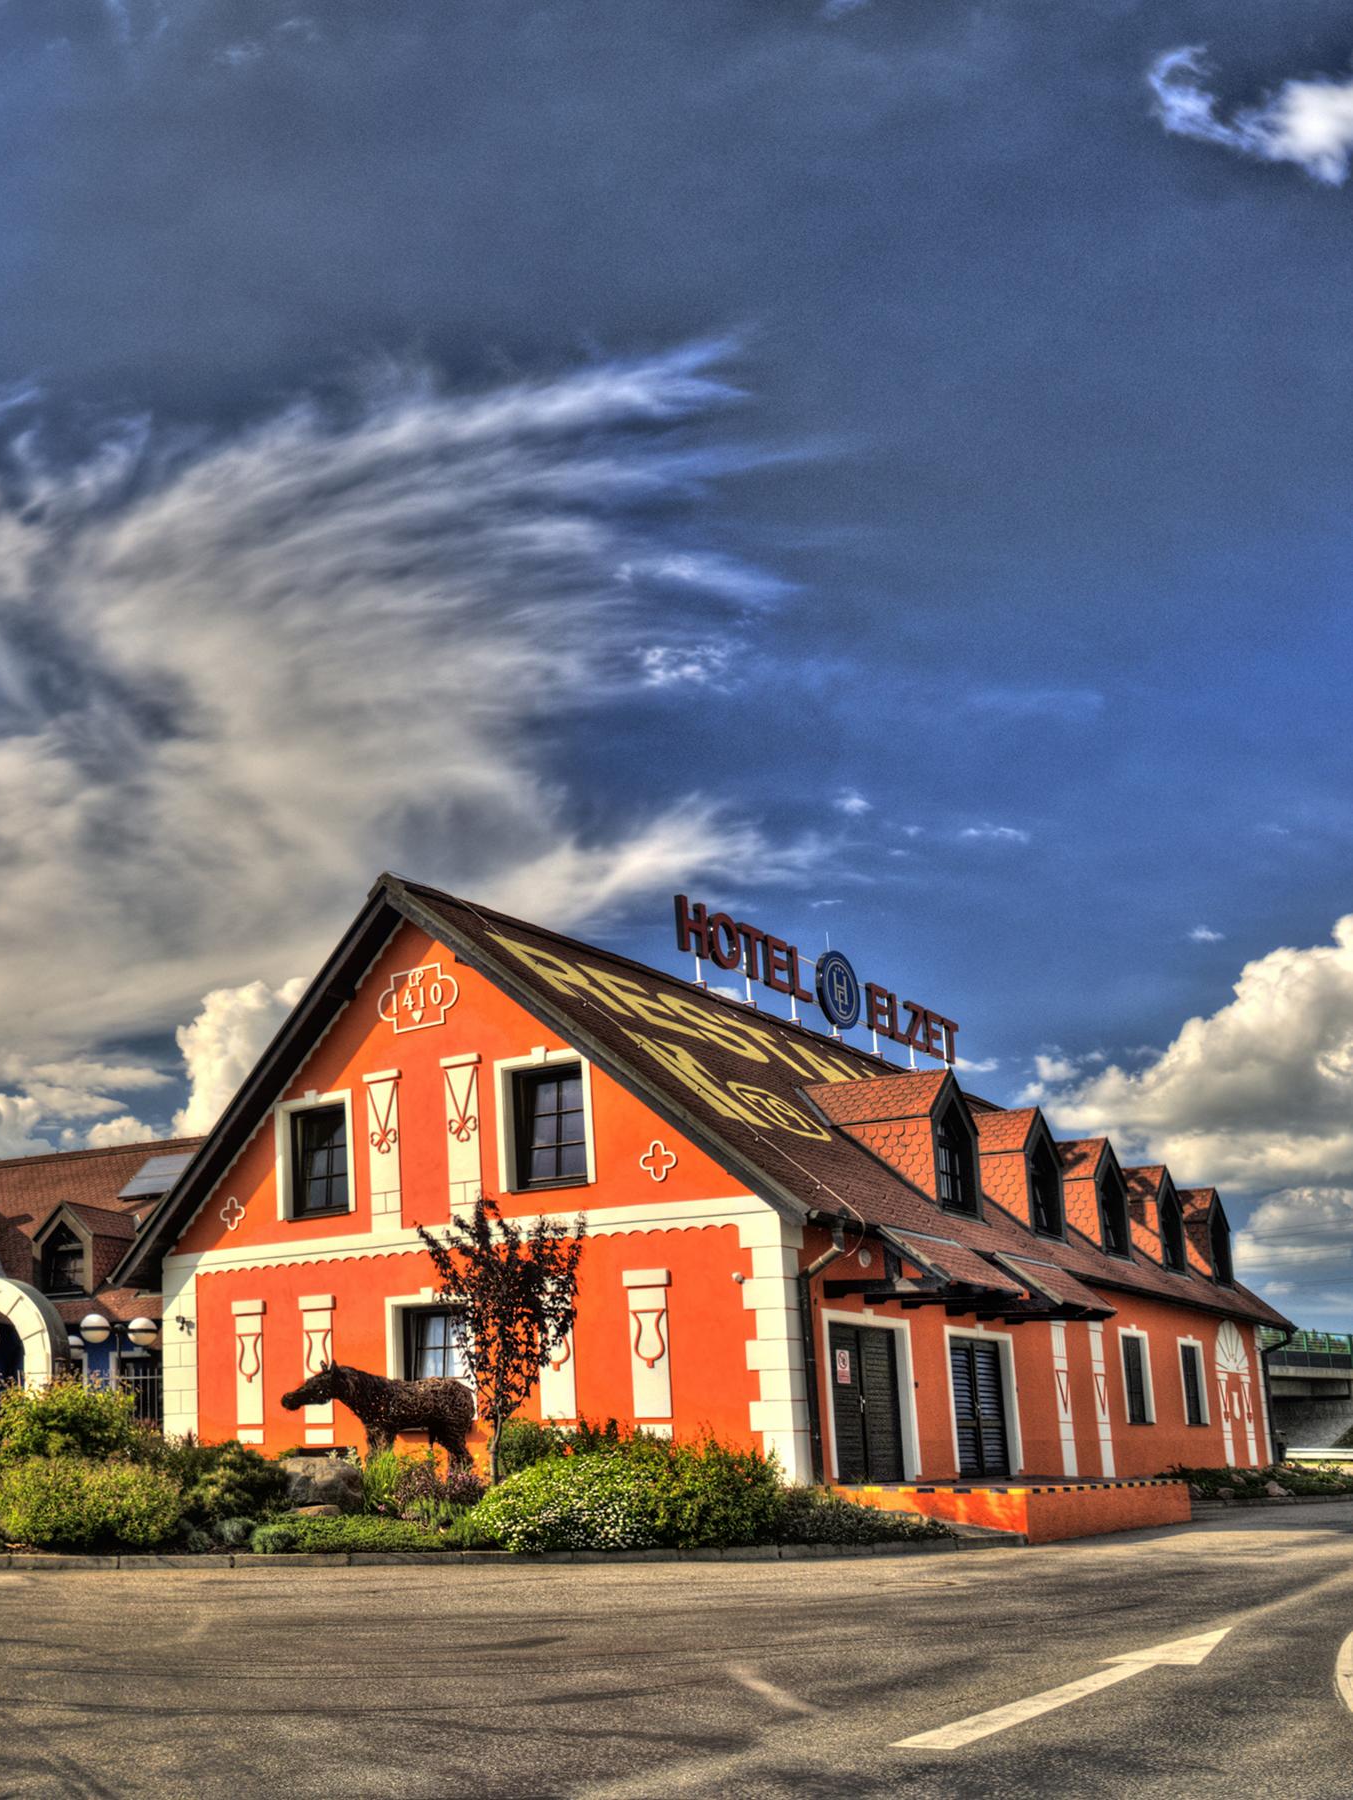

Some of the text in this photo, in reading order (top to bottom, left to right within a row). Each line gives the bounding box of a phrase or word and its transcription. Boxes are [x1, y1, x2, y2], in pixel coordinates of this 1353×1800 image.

[392, 983, 442, 1015] 1410
[674, 894, 813, 1003] HOTEL
[865, 982, 959, 1064] ELZET
[741, 1091, 811, 1131] 79
